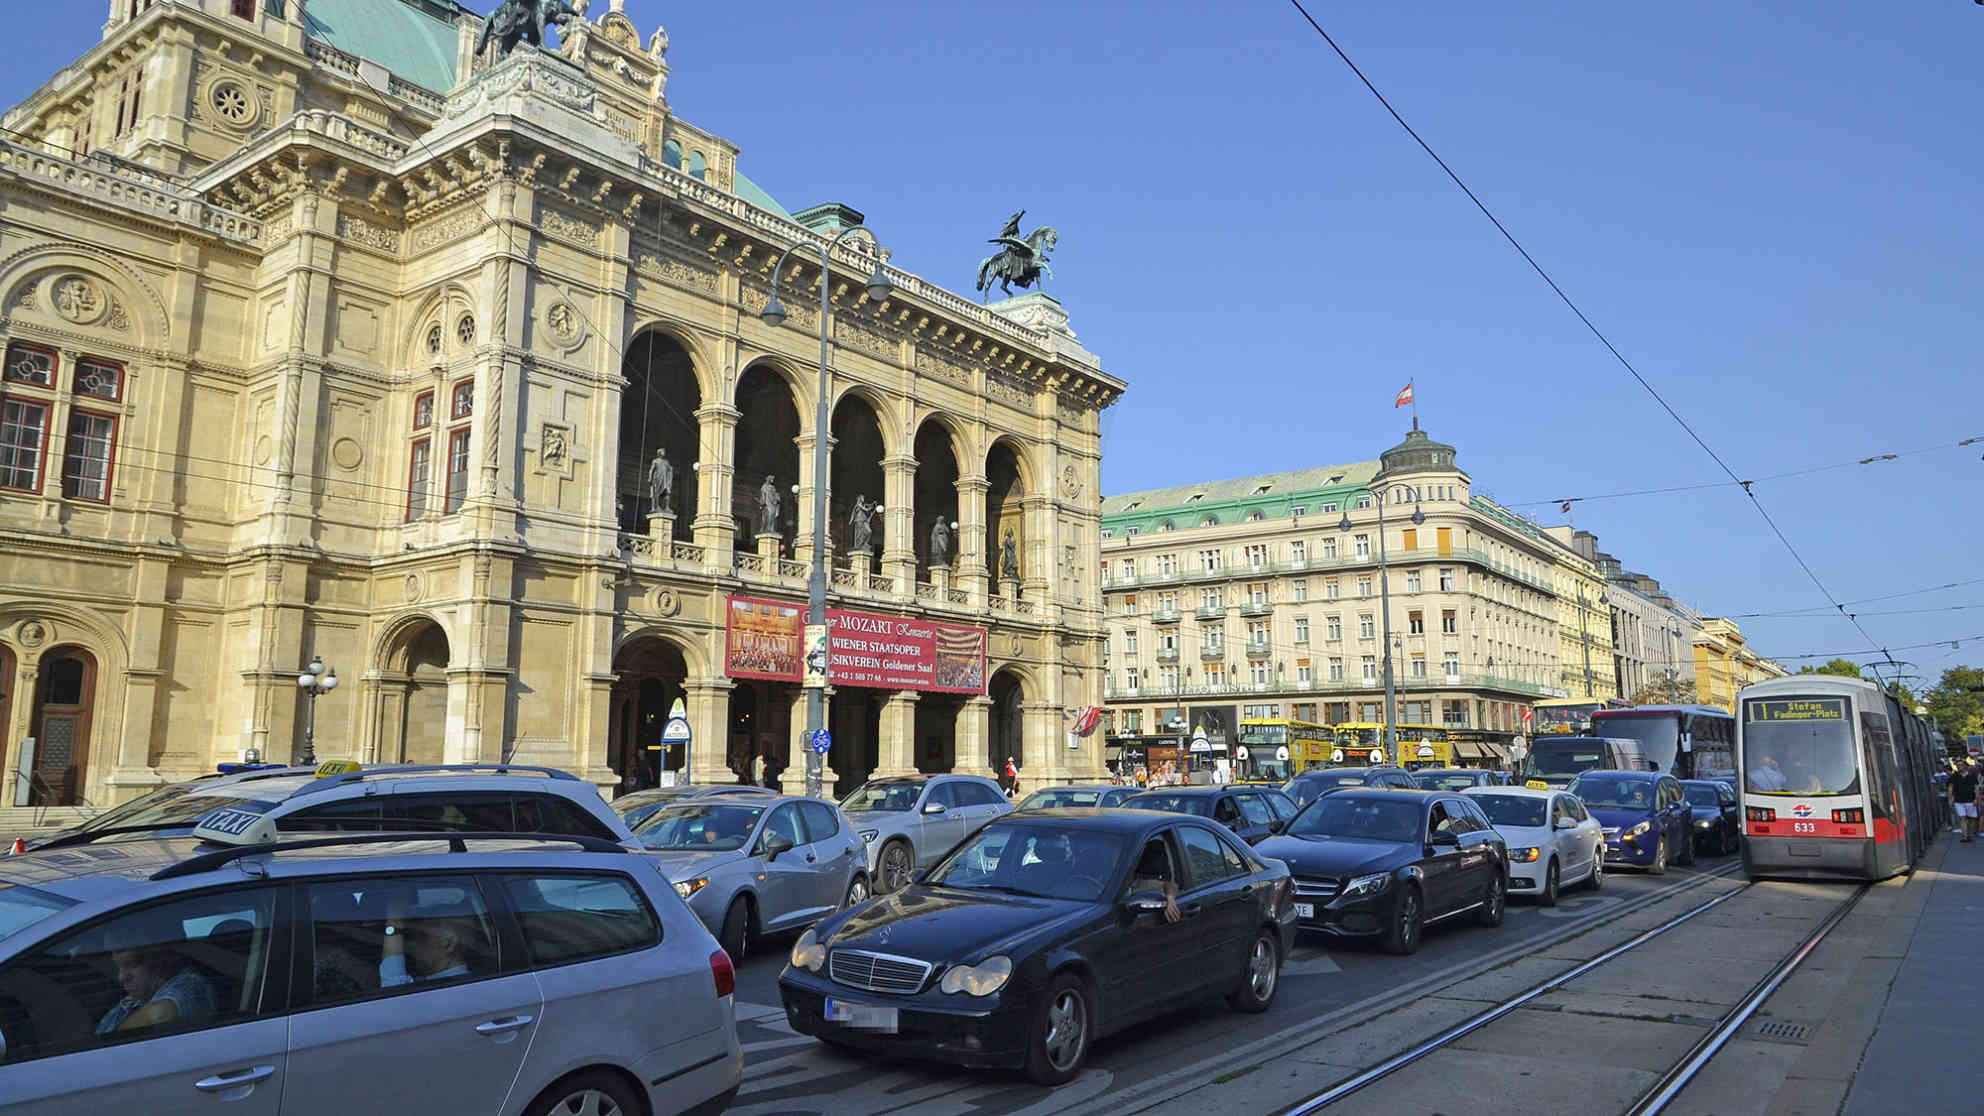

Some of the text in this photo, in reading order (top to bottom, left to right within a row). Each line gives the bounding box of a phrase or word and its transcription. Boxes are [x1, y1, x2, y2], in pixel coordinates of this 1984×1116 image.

[840, 615, 893, 634] MOZART
[832, 637, 921, 656] WIENER STAATSOPER
[883, 660, 915, 671] Goldener
[917, 662, 933, 672] Saal
[1762, 703, 1768, 720] 1
[205, 812, 258, 834] TAXI
